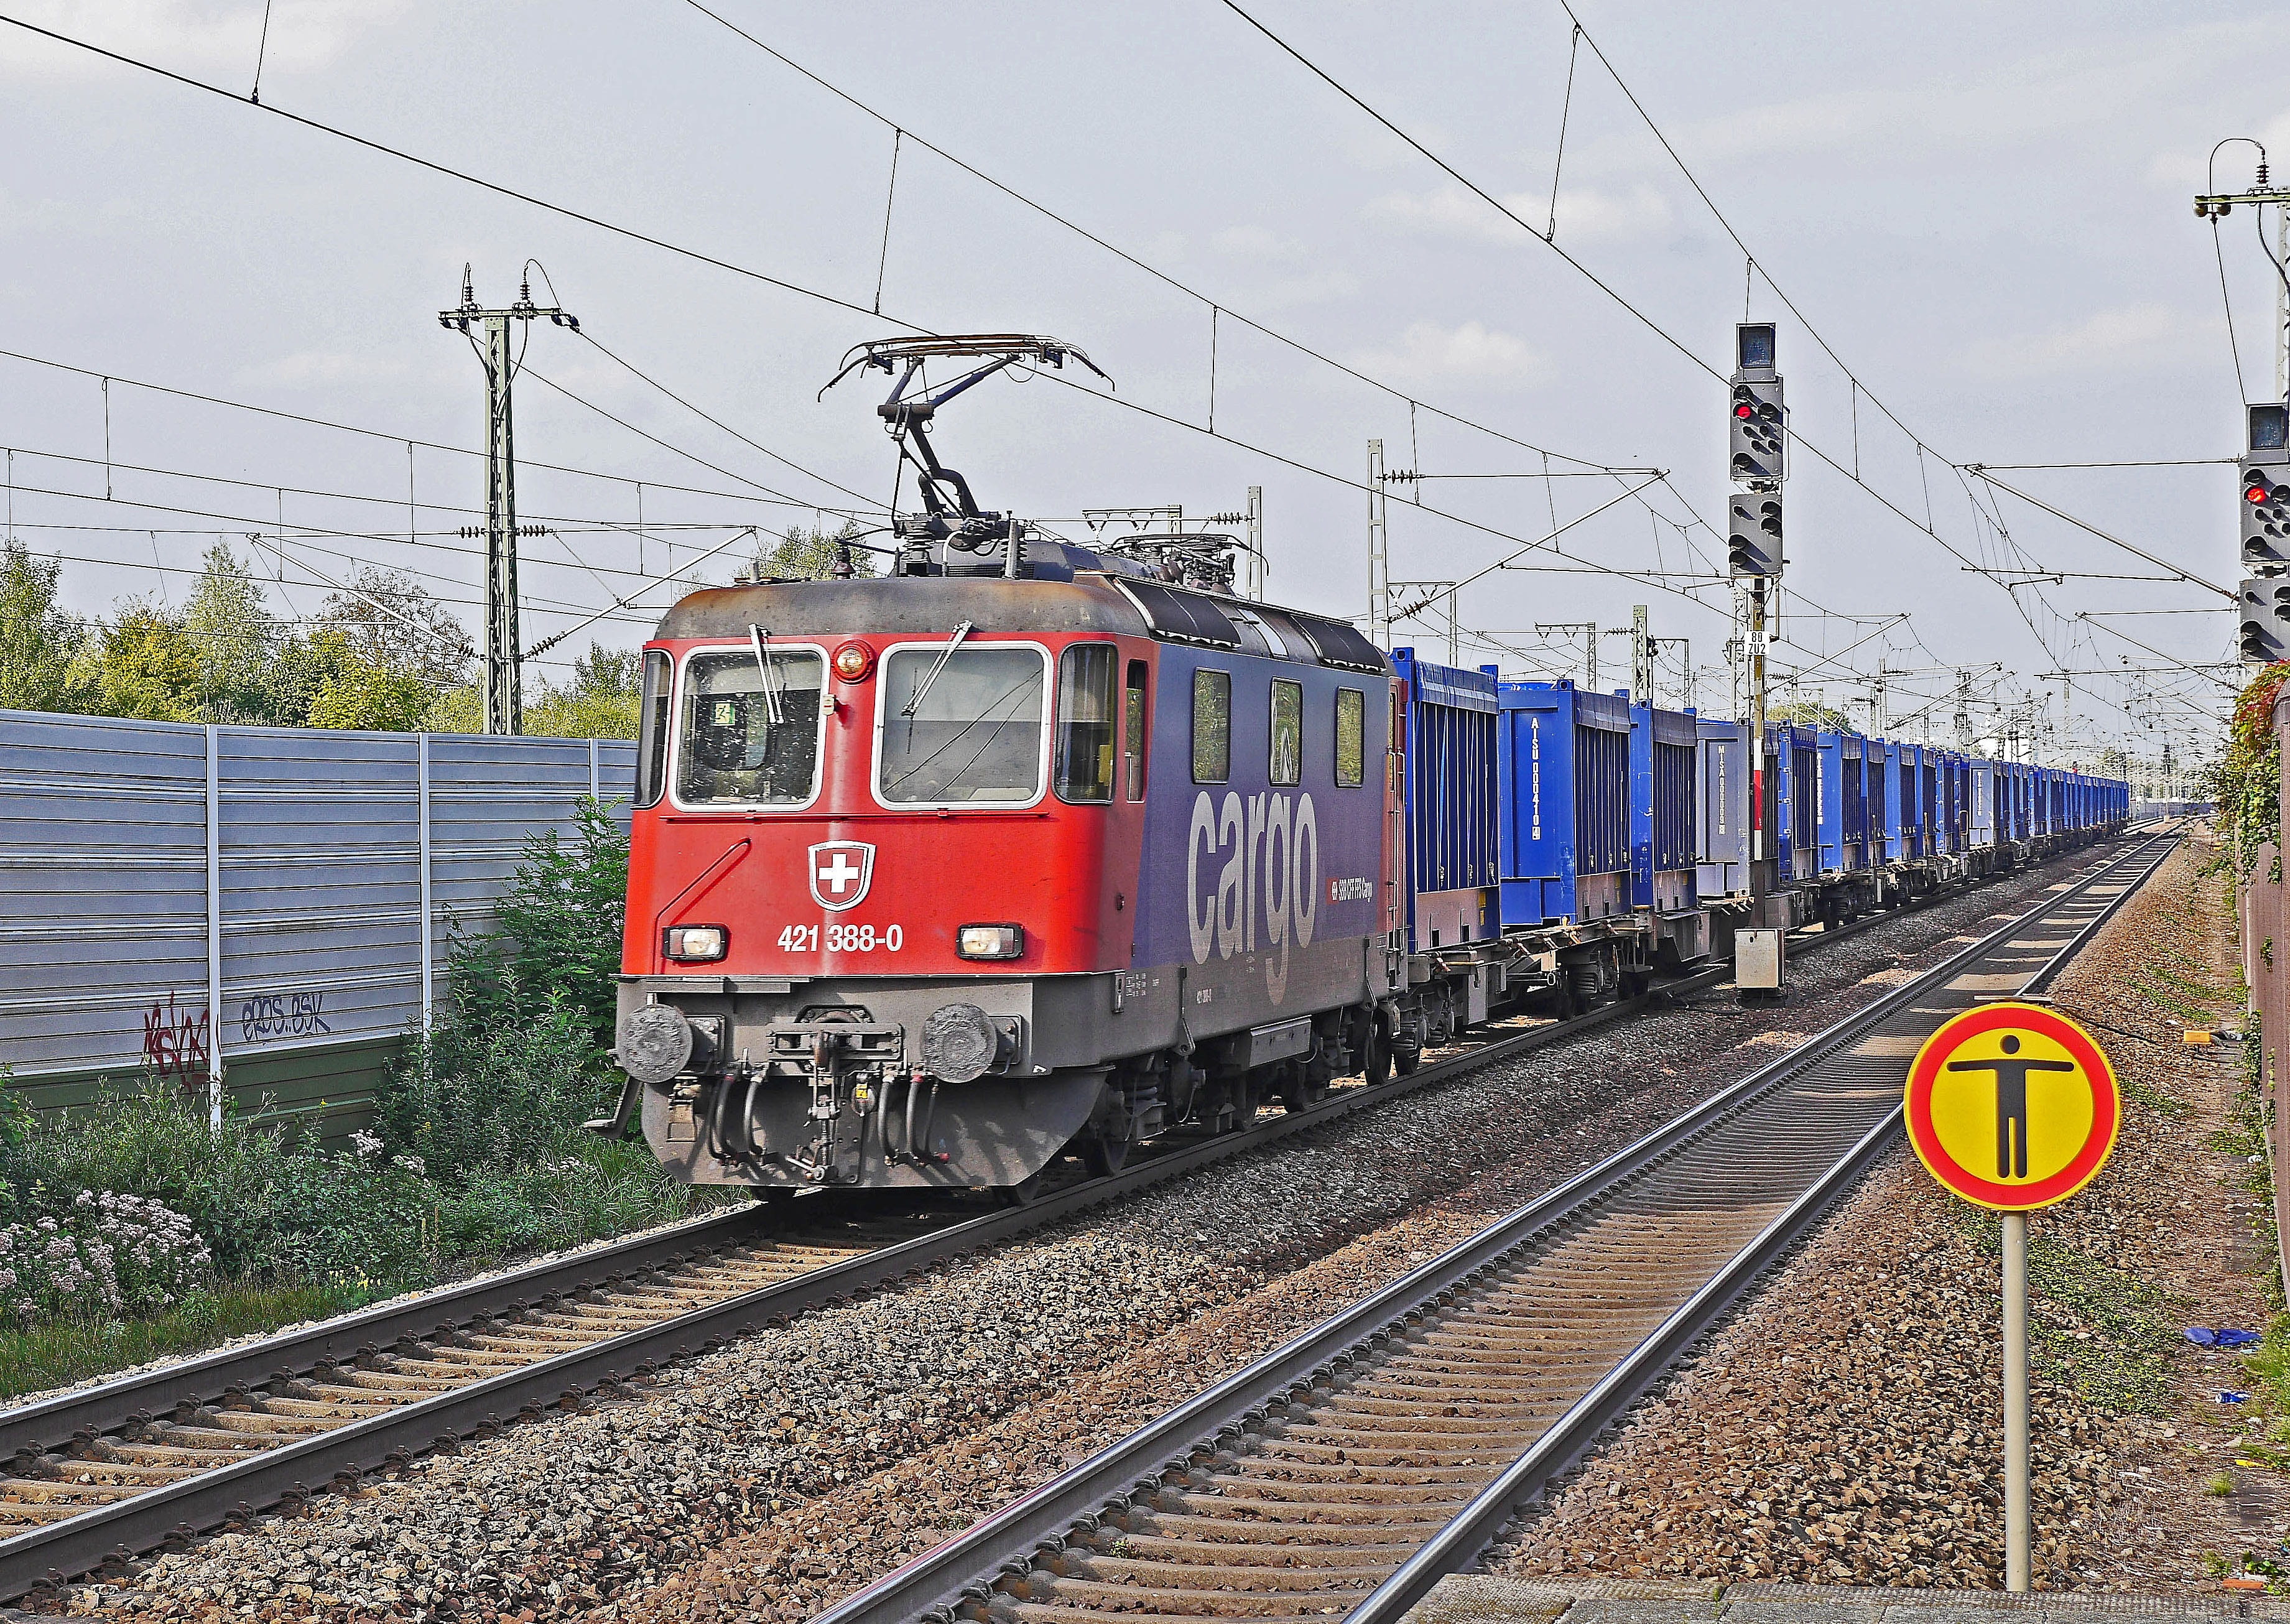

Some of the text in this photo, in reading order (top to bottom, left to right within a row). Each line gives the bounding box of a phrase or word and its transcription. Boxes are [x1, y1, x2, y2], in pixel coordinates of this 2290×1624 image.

[1749, 644, 1765, 654] ZU2
[1752, 632, 1763, 642] 80
[1188, 791, 1317, 1005] cargo
[1362, 876, 1373, 902] Cargo
[777, 924, 903, 952] 421 388-0
